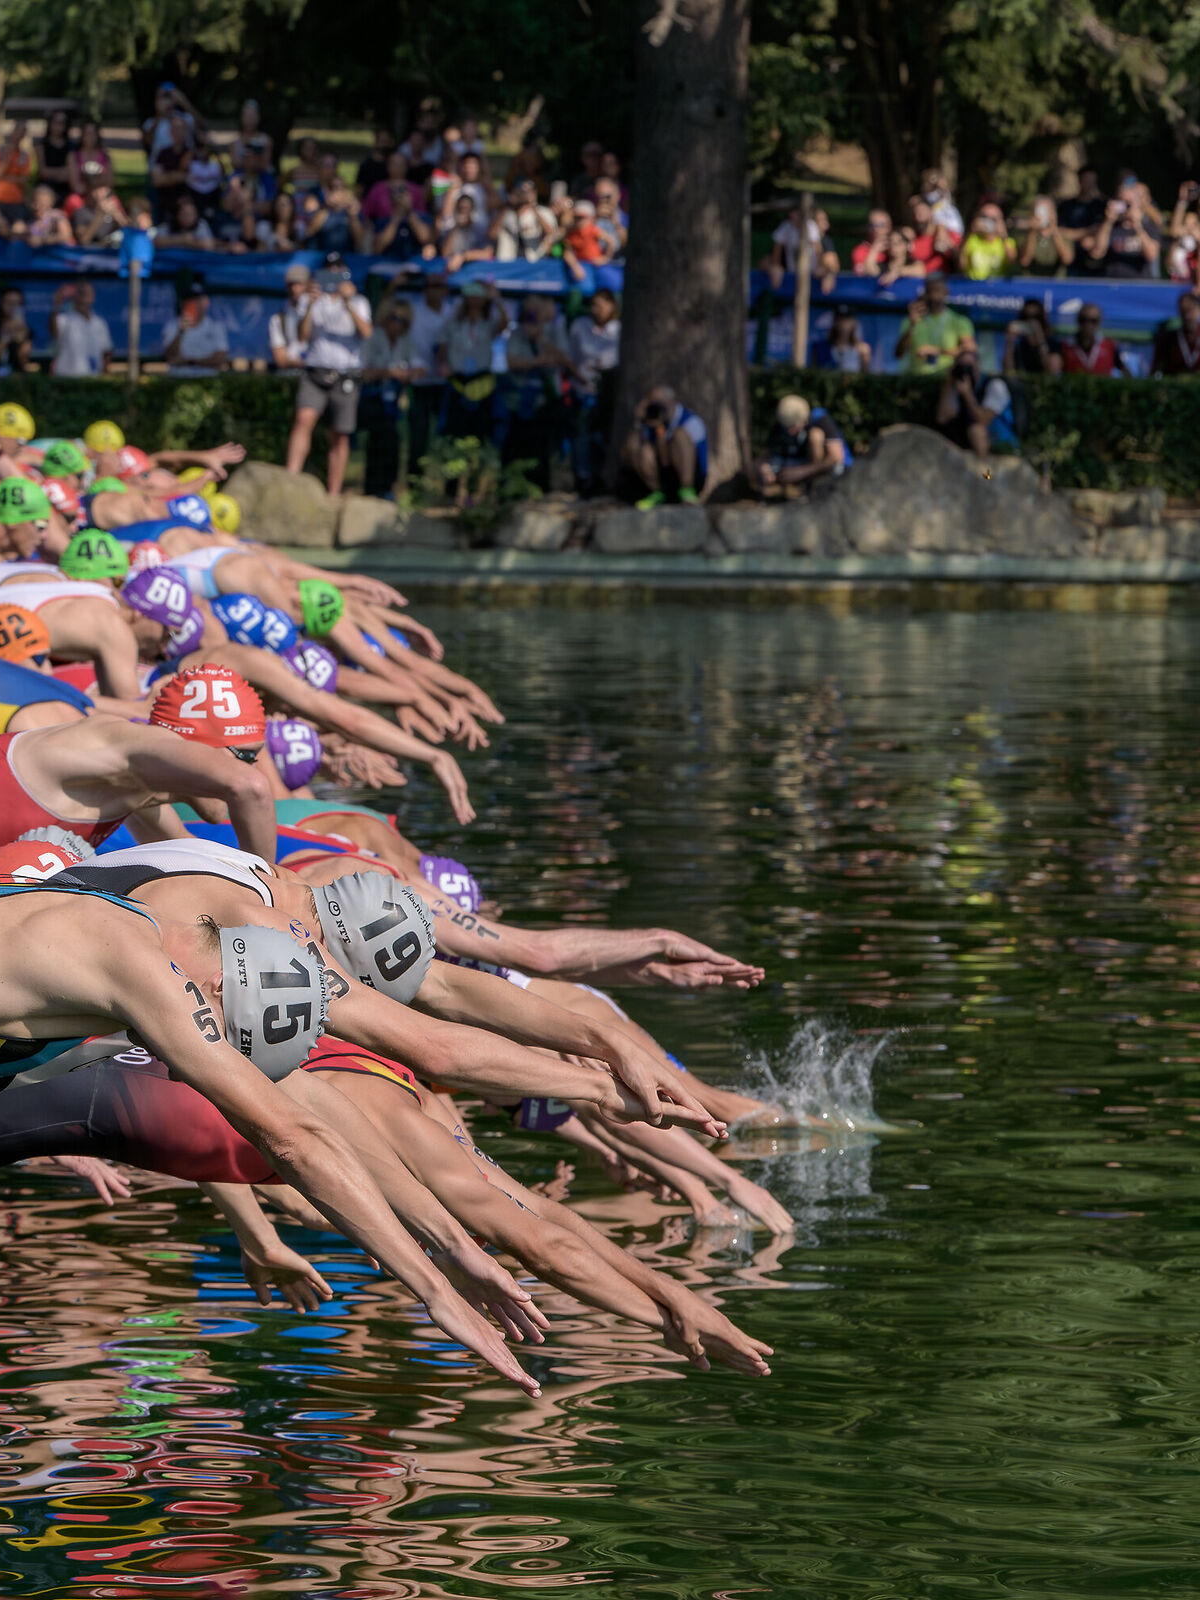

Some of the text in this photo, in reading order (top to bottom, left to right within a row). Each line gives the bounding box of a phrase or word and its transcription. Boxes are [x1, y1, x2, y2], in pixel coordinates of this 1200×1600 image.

[146, 575, 188, 613] 60
[318, 592, 337, 624] 45
[227, 599, 264, 632] 37
[293, 647, 335, 689] 59
[179, 679, 241, 719] 25
[282, 723, 314, 765] 54
[335, 918, 352, 945] NTT
[359, 900, 422, 982] 19
[451, 912, 500, 941] 51
[237, 958, 248, 987] NTT
[184, 980, 222, 1044] 15
[260, 957, 312, 1045] 15
